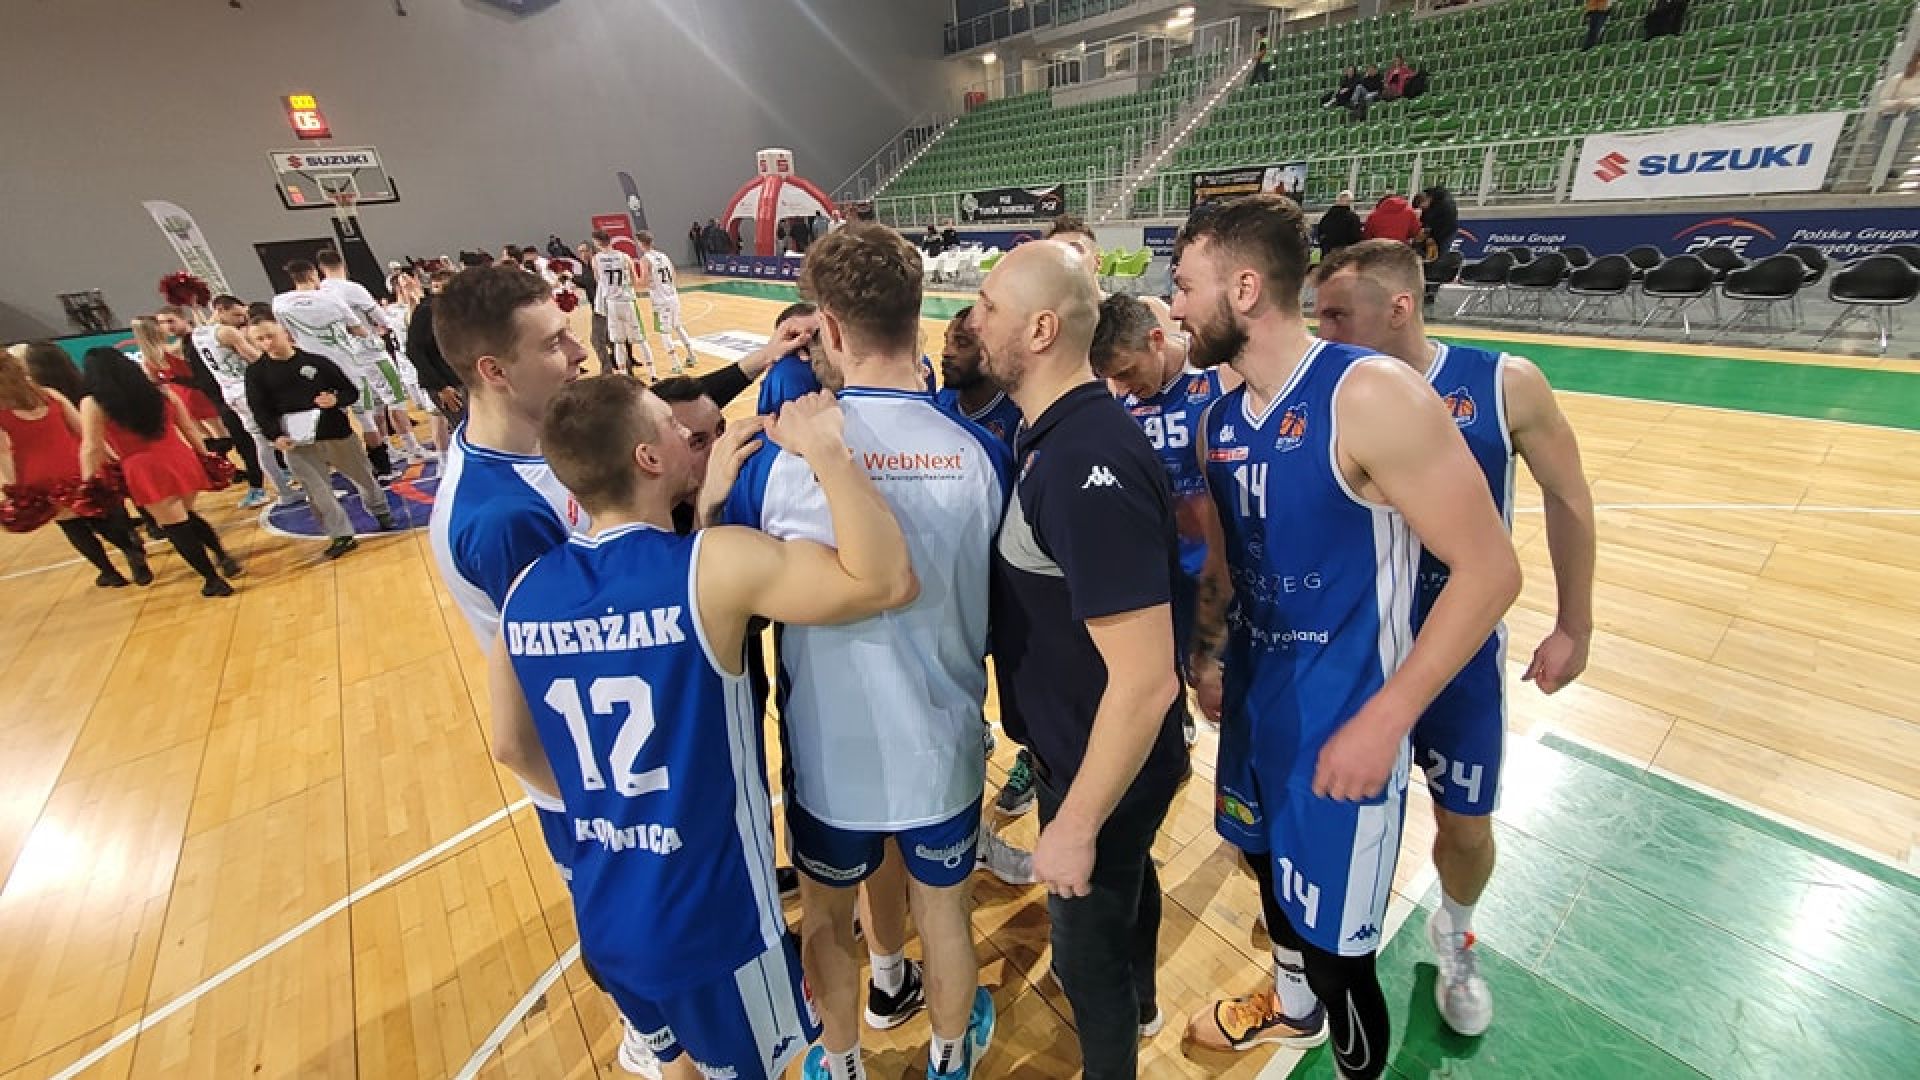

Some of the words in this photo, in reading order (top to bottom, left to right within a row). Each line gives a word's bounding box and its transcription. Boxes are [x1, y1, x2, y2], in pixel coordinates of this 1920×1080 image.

[306, 154, 369, 167] SUZUKI
[1638, 143, 1813, 177] SUZUKI
[1487, 233, 1525, 242] Polska
[1528, 233, 1567, 246] Grupa
[1793, 229, 1852, 240] Polska
[1858, 228, 1920, 243] Grupa
[604, 269, 623, 287] 77
[1144, 411, 1189, 449] 95
[863, 451, 961, 471] WebNext
[1233, 462, 1269, 519] 14
[507, 605, 687, 657] DZIERŻAK
[543, 675, 670, 798] 12
[1425, 749, 1484, 803] 24
[1278, 856, 1321, 929] 14
